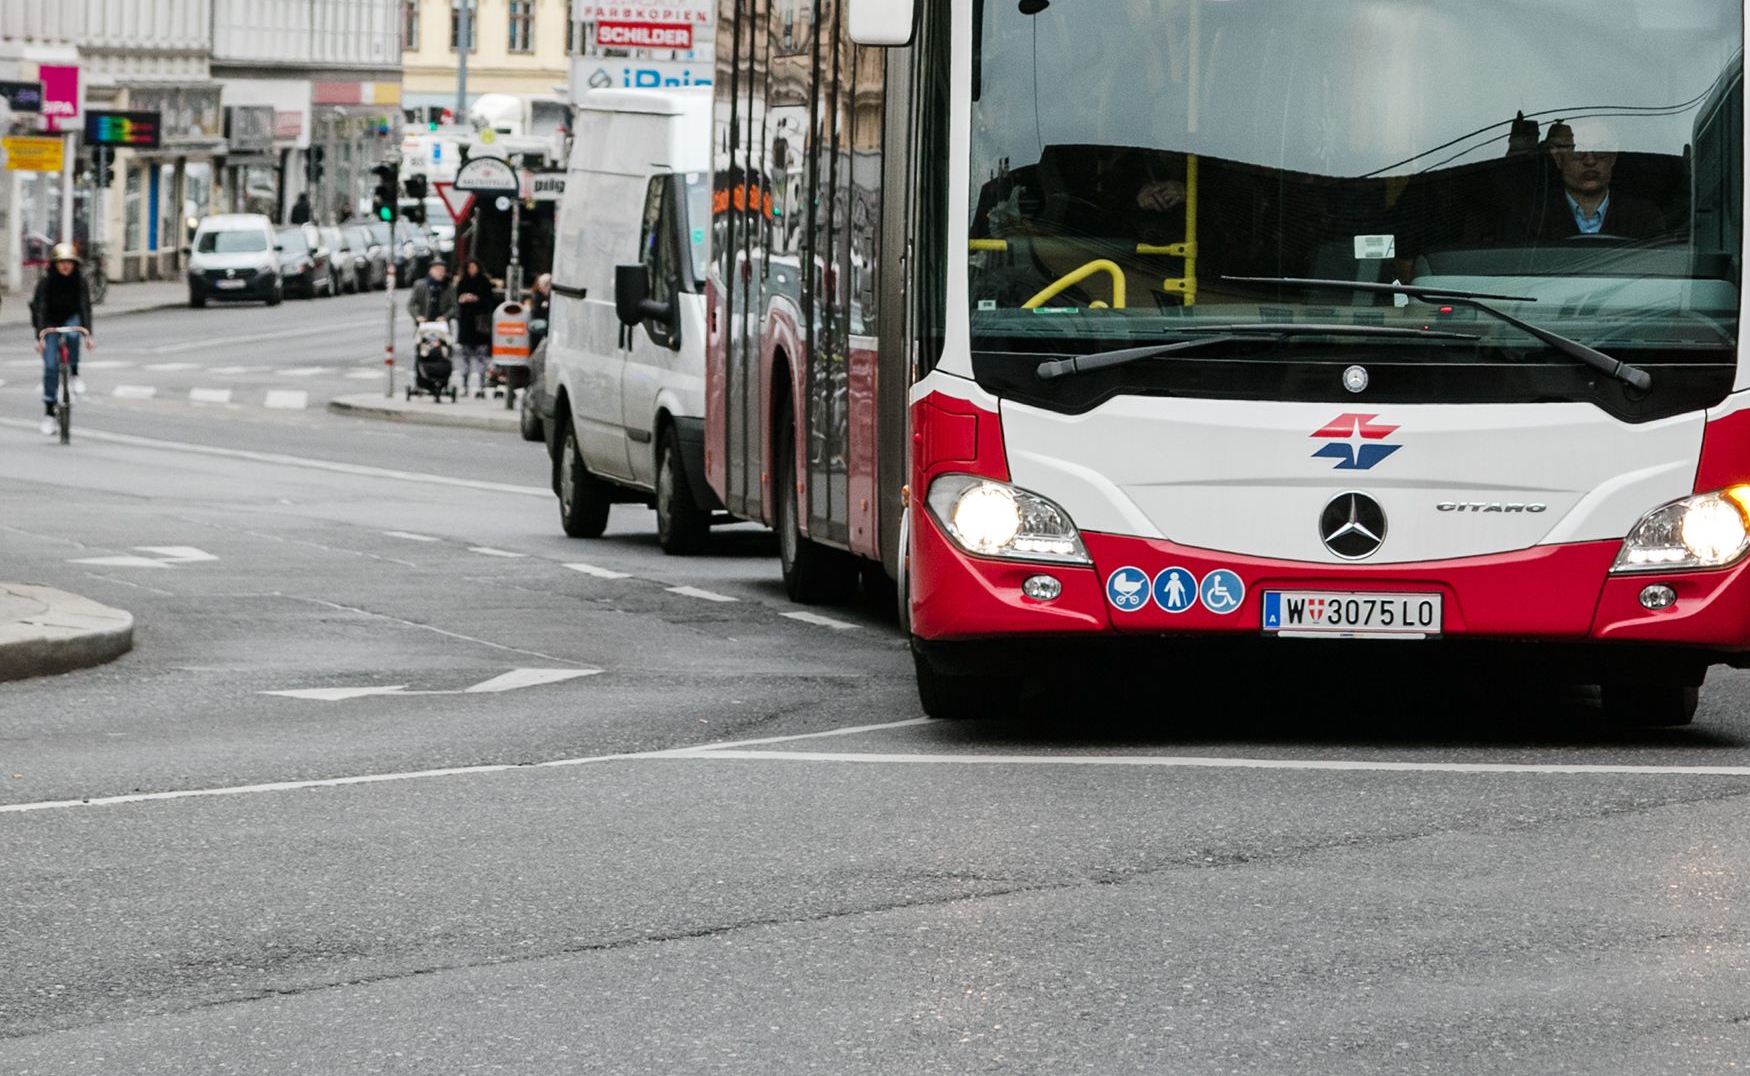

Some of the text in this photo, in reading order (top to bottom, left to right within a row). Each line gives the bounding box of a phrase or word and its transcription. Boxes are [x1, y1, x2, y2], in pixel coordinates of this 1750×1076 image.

[584, 6, 707, 22] FARBKOPIEN
[599, 26, 689, 45] SCHILDER
[1436, 502, 1547, 513] CITARO
